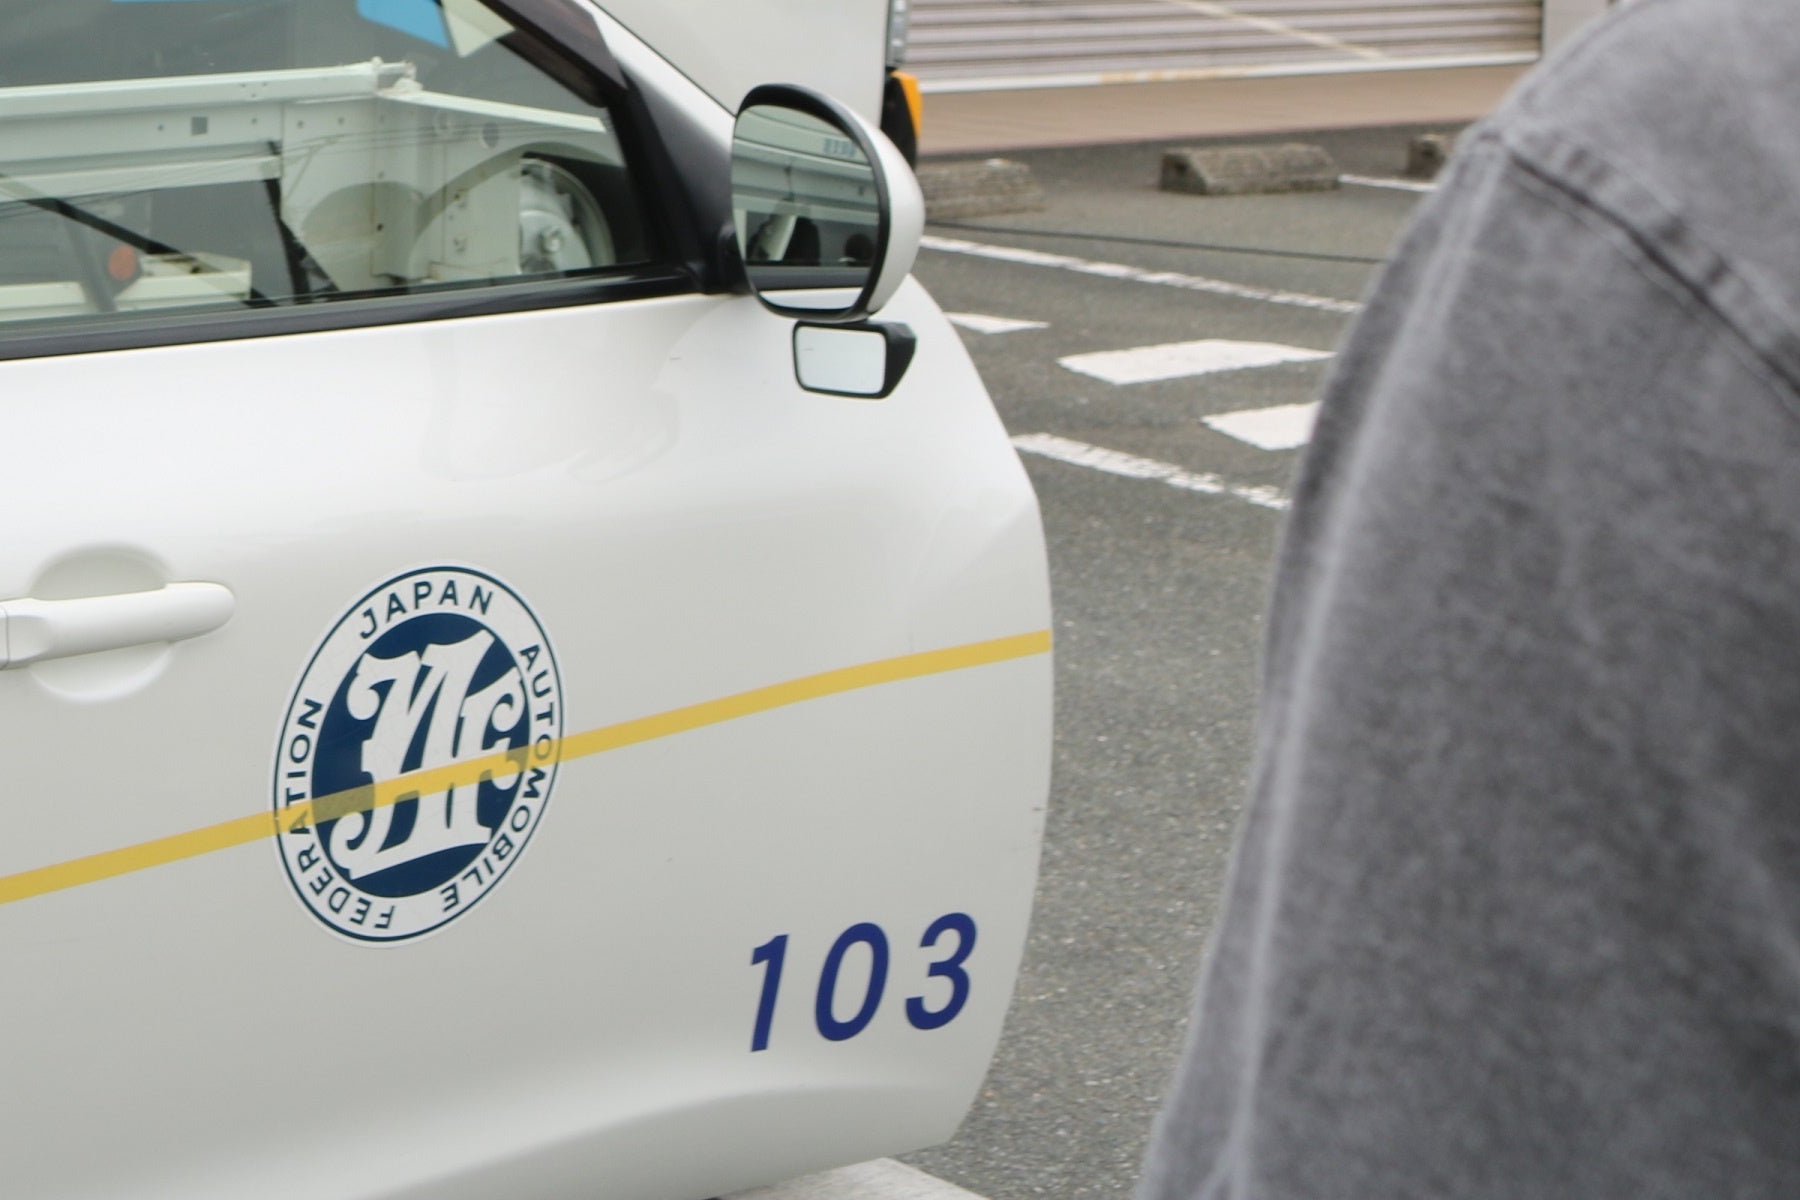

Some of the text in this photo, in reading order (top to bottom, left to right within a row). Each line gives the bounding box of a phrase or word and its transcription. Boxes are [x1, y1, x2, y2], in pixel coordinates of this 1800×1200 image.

[285, 579, 557, 930] JAPAN AUTOMOBILE FEDERATION
[750, 912, 977, 1052] 103
